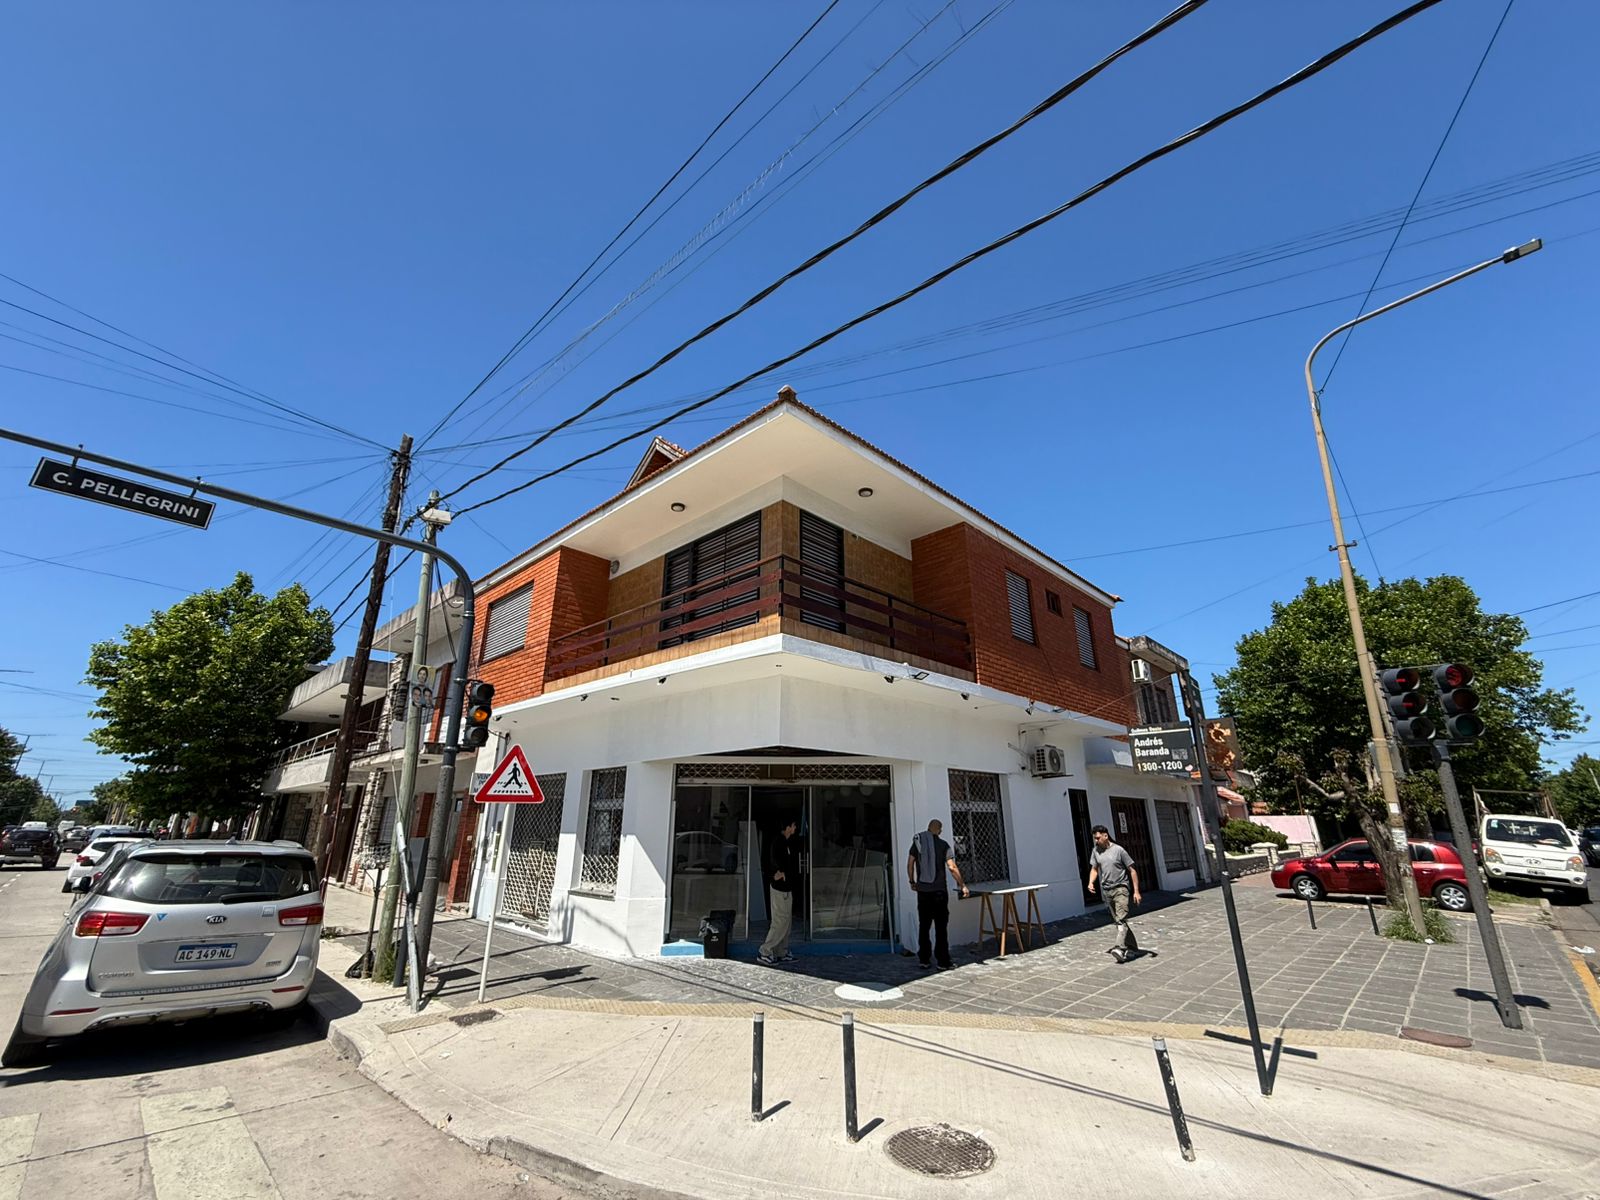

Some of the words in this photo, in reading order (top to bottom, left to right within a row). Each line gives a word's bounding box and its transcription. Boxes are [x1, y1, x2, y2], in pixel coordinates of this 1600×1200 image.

[52, 471, 73, 486] C.
[80, 478, 200, 519] PELLEGRINI
[1134, 736, 1164, 747] Andrés
[1134, 746, 1170, 757] Baranda
[1137, 760, 1183, 771] 1300-1200
[208, 915, 225, 923] KIA
[178, 950, 193, 960] AC
[196, 949, 217, 960] 149
[218, 949, 232, 958] NL
